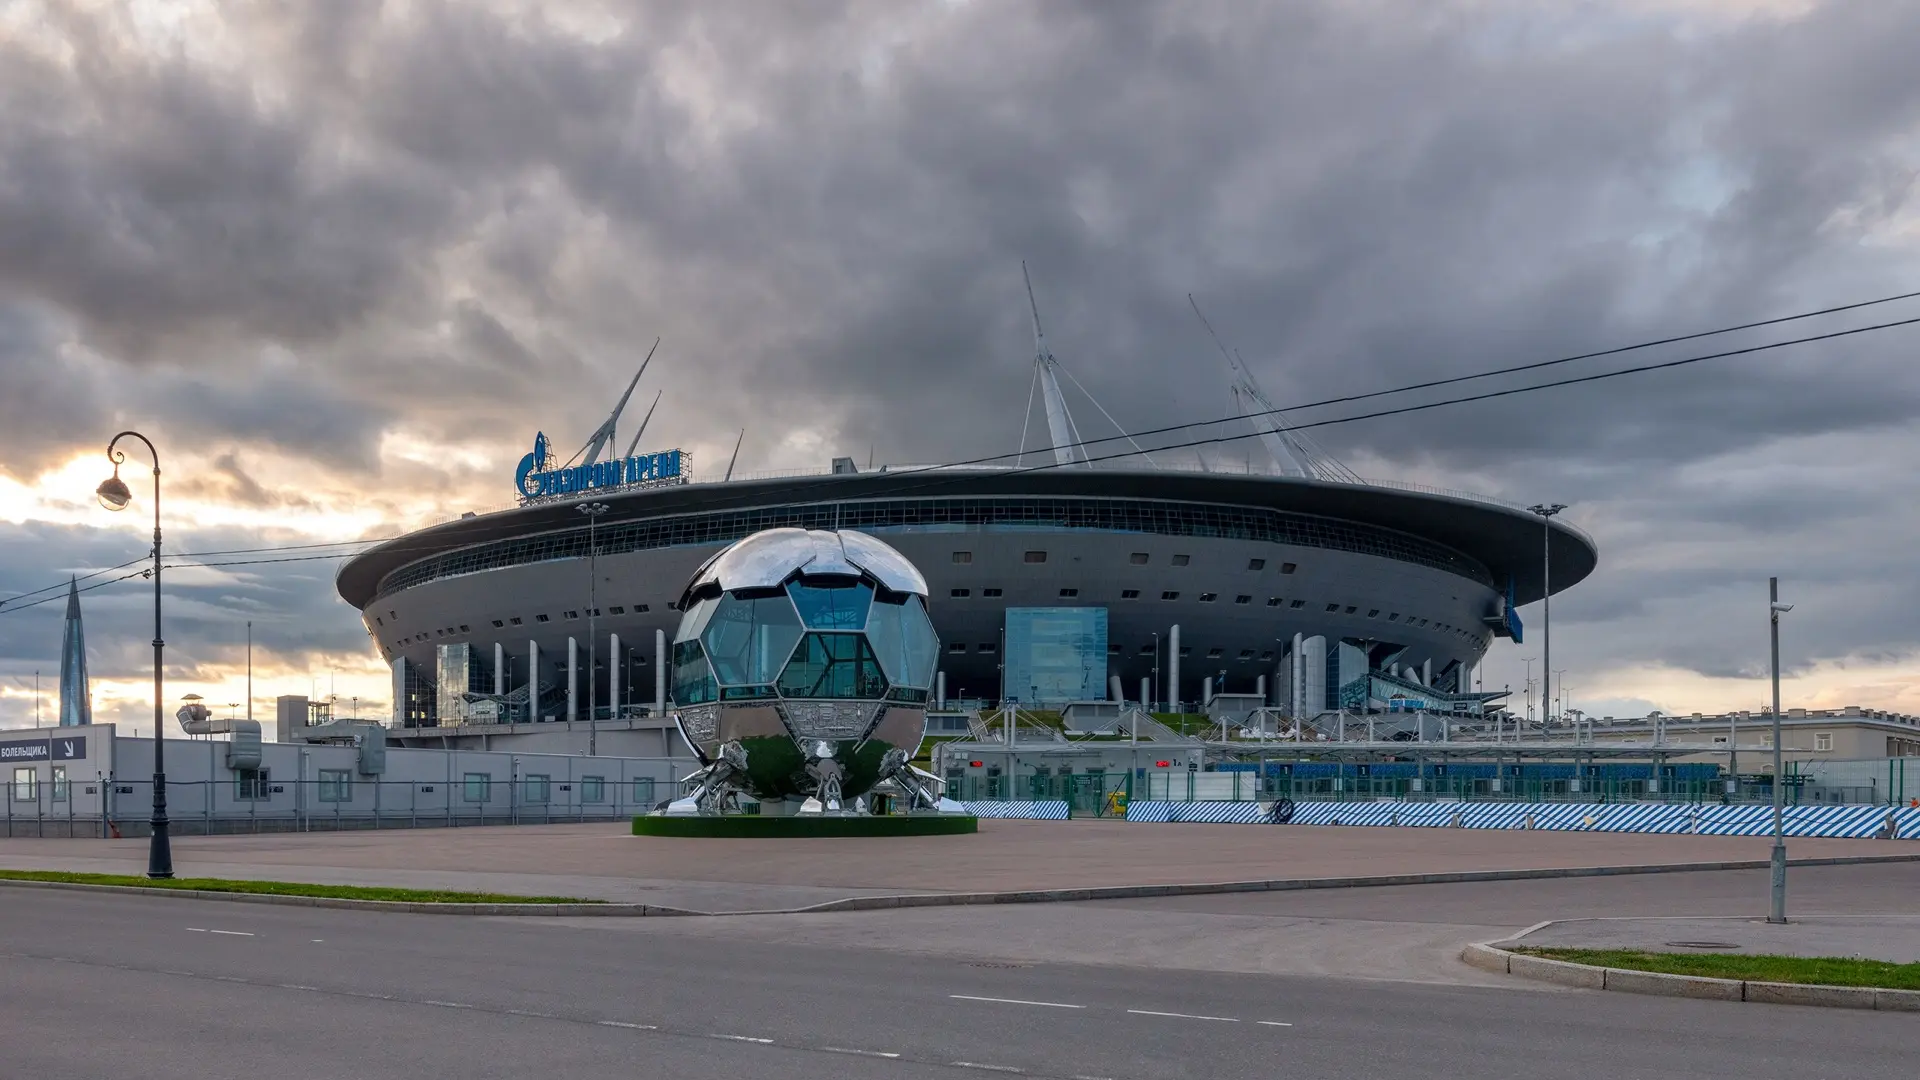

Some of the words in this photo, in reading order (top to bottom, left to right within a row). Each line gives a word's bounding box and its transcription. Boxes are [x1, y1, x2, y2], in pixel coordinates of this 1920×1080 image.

[545, 460, 621, 496] ГАЗПРОМ
[626, 450, 681, 483] АРЕНА
[1, 745, 47, 758] БОЛЕЛЬЩИКА
